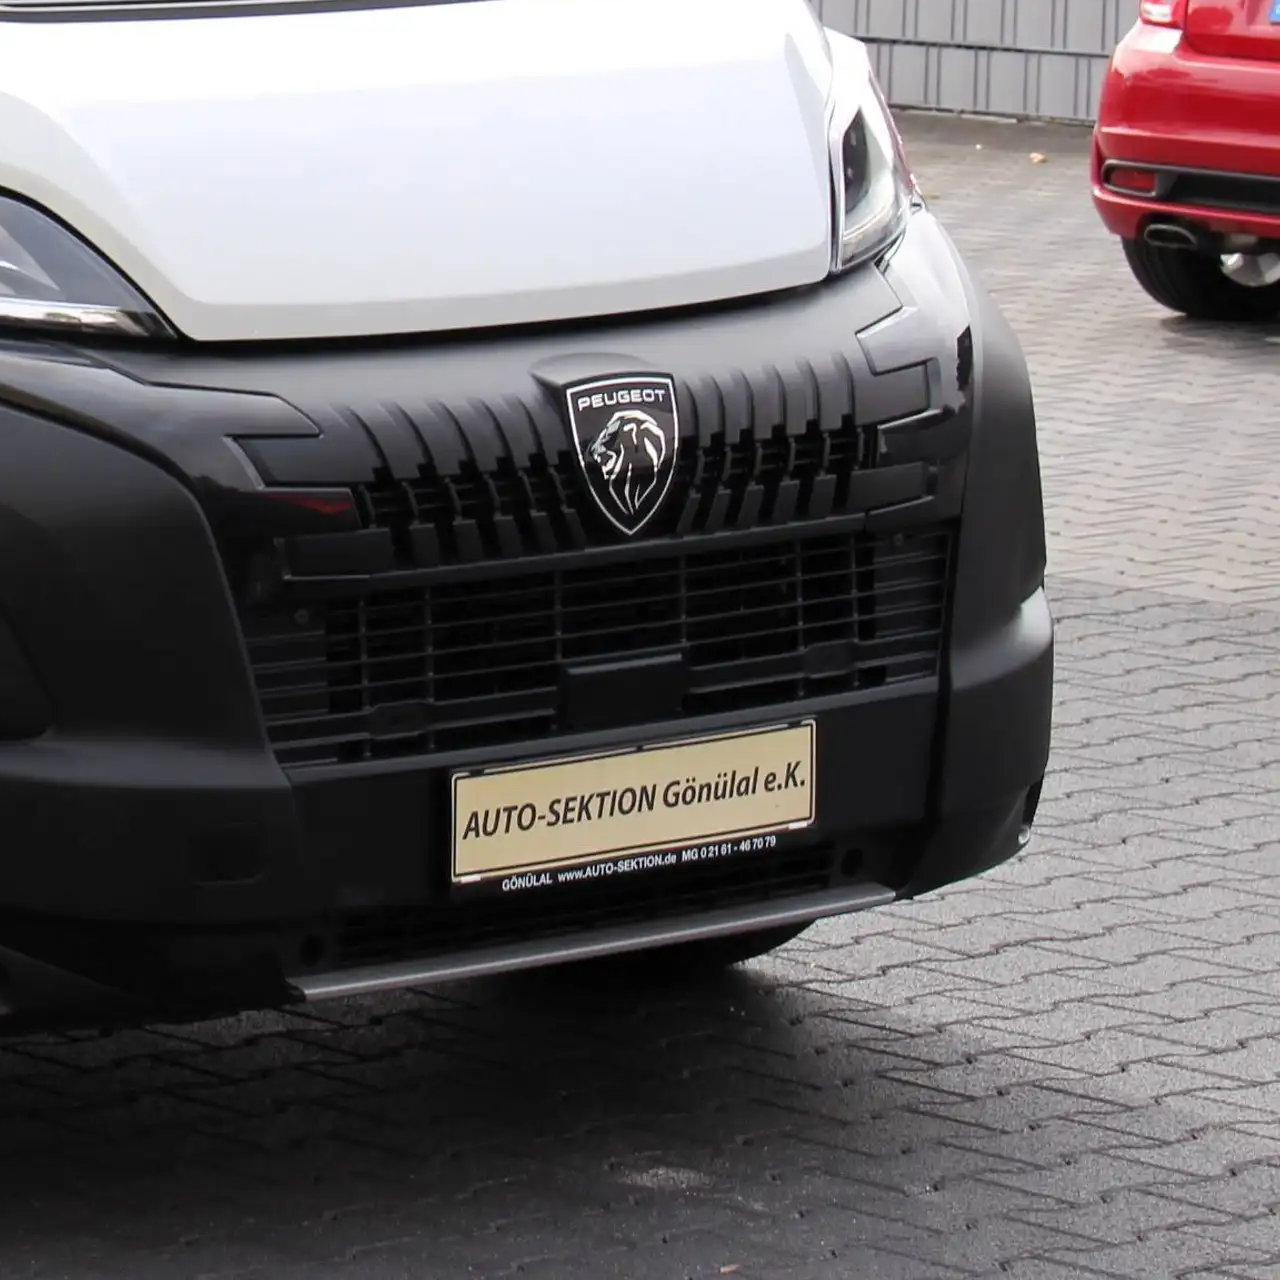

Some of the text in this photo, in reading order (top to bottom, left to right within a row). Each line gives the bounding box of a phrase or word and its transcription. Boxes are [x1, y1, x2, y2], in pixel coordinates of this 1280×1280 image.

[577, 389, 666, 411] PEUGEOT
[462, 761, 806, 840] AUTO-SEKTION Gönülal e.K.
[502, 872, 552, 891] GÖNÜLAL
[558, 852, 677, 882] www.AUTO-SEKTION.de
[681, 848, 699, 862] MG
